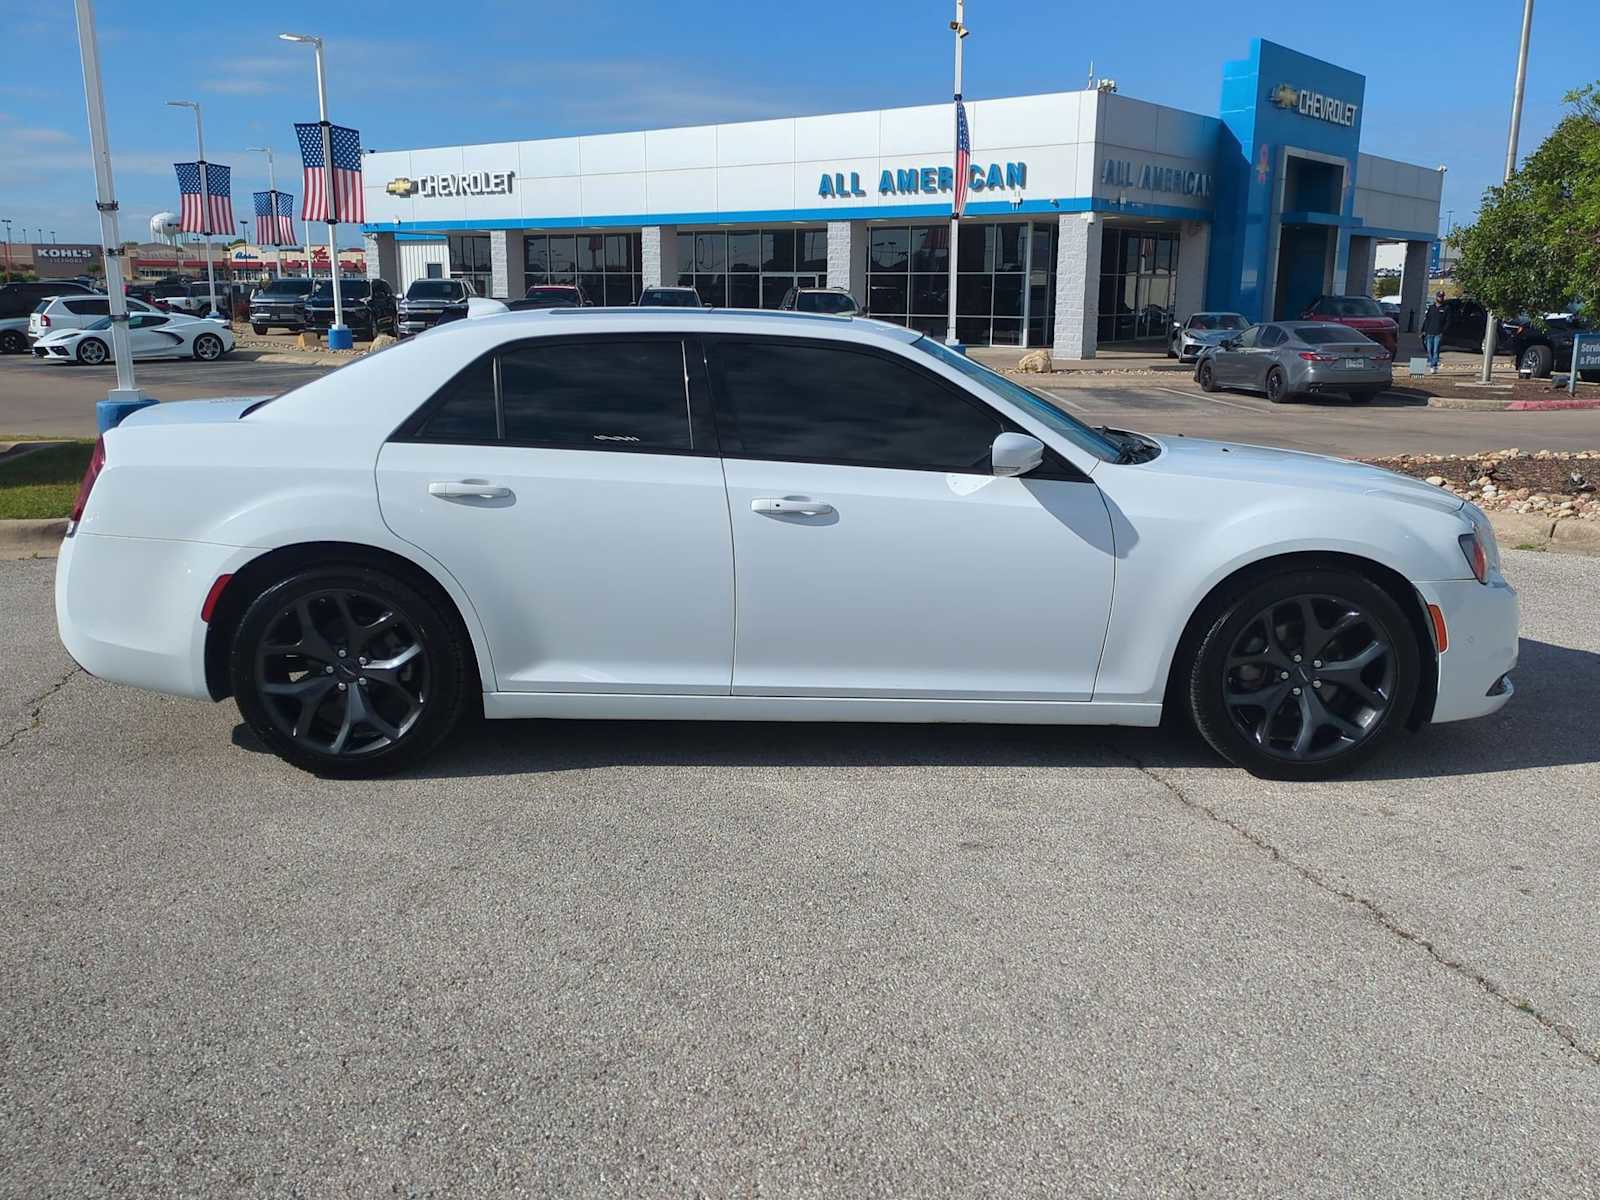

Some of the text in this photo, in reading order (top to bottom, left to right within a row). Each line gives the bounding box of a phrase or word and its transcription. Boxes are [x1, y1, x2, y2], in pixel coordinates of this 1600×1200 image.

[1299, 89, 1357, 127] CHEVROLET
[418, 170, 515, 198] CHEVROLET
[818, 162, 1027, 199] ALL AMERCAN
[1103, 159, 1215, 198] ALL AMERICAN
[37, 248, 92, 258] KOHL'S
